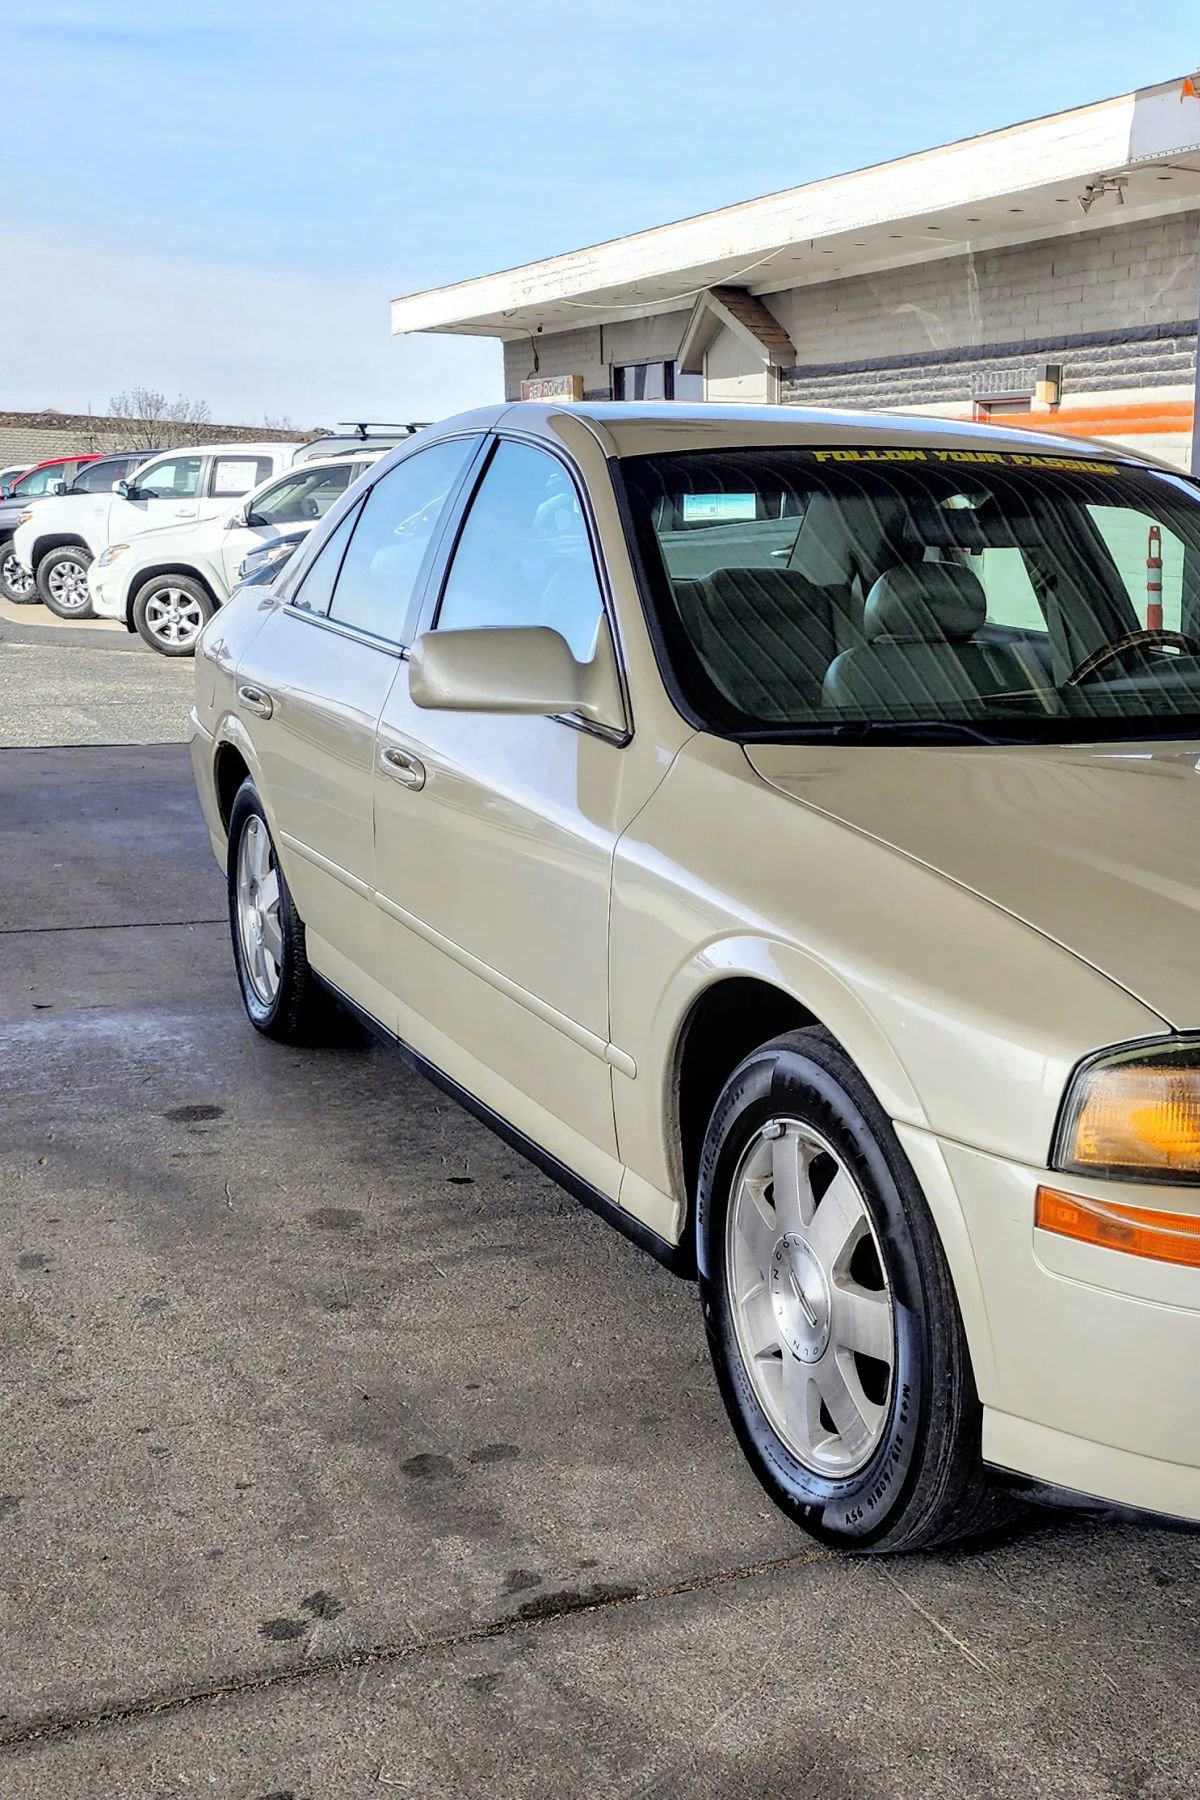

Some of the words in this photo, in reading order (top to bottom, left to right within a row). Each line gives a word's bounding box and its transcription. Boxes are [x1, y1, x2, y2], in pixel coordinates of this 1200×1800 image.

[812, 450, 928, 462] FOLLOW
[932, 450, 1006, 465] YOUR
[1009, 454, 1121, 475] PASSION
